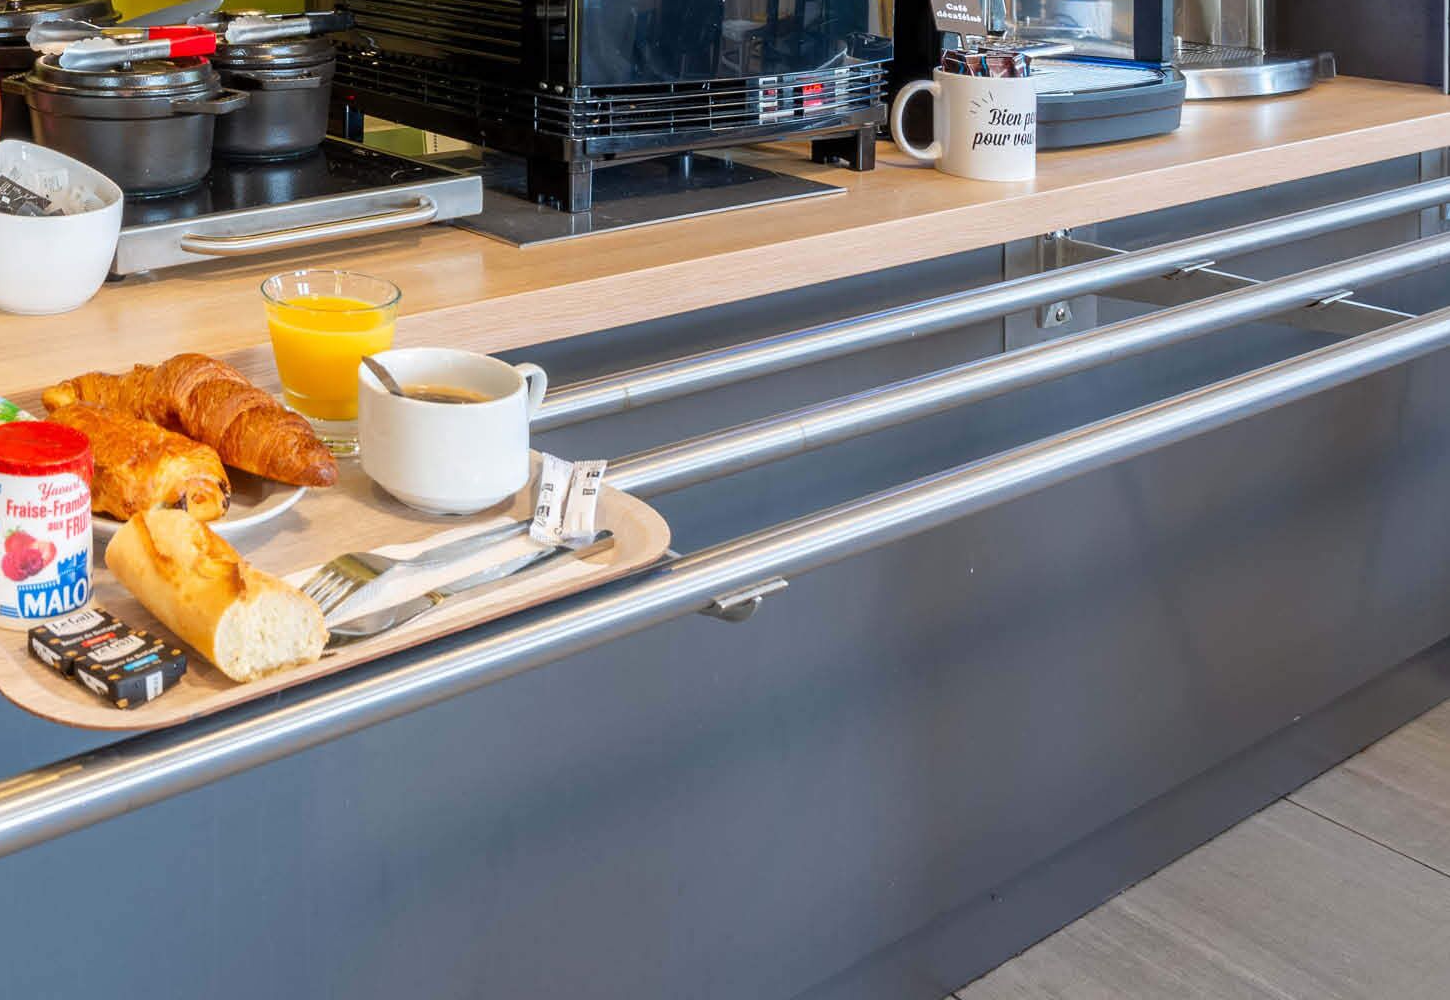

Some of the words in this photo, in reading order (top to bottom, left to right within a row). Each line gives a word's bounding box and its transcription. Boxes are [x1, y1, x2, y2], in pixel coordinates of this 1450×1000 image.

[936, 9, 983, 23] décaféiné
[945, 2, 968, 13] Café
[988, 108, 1022, 126] Bien
[972, 131, 1011, 150] pour
[1013, 132, 1033, 146] vou
[23, 578, 88, 617] MALO
[51, 620, 67, 632] Le
[68, 610, 96, 627] Gall
